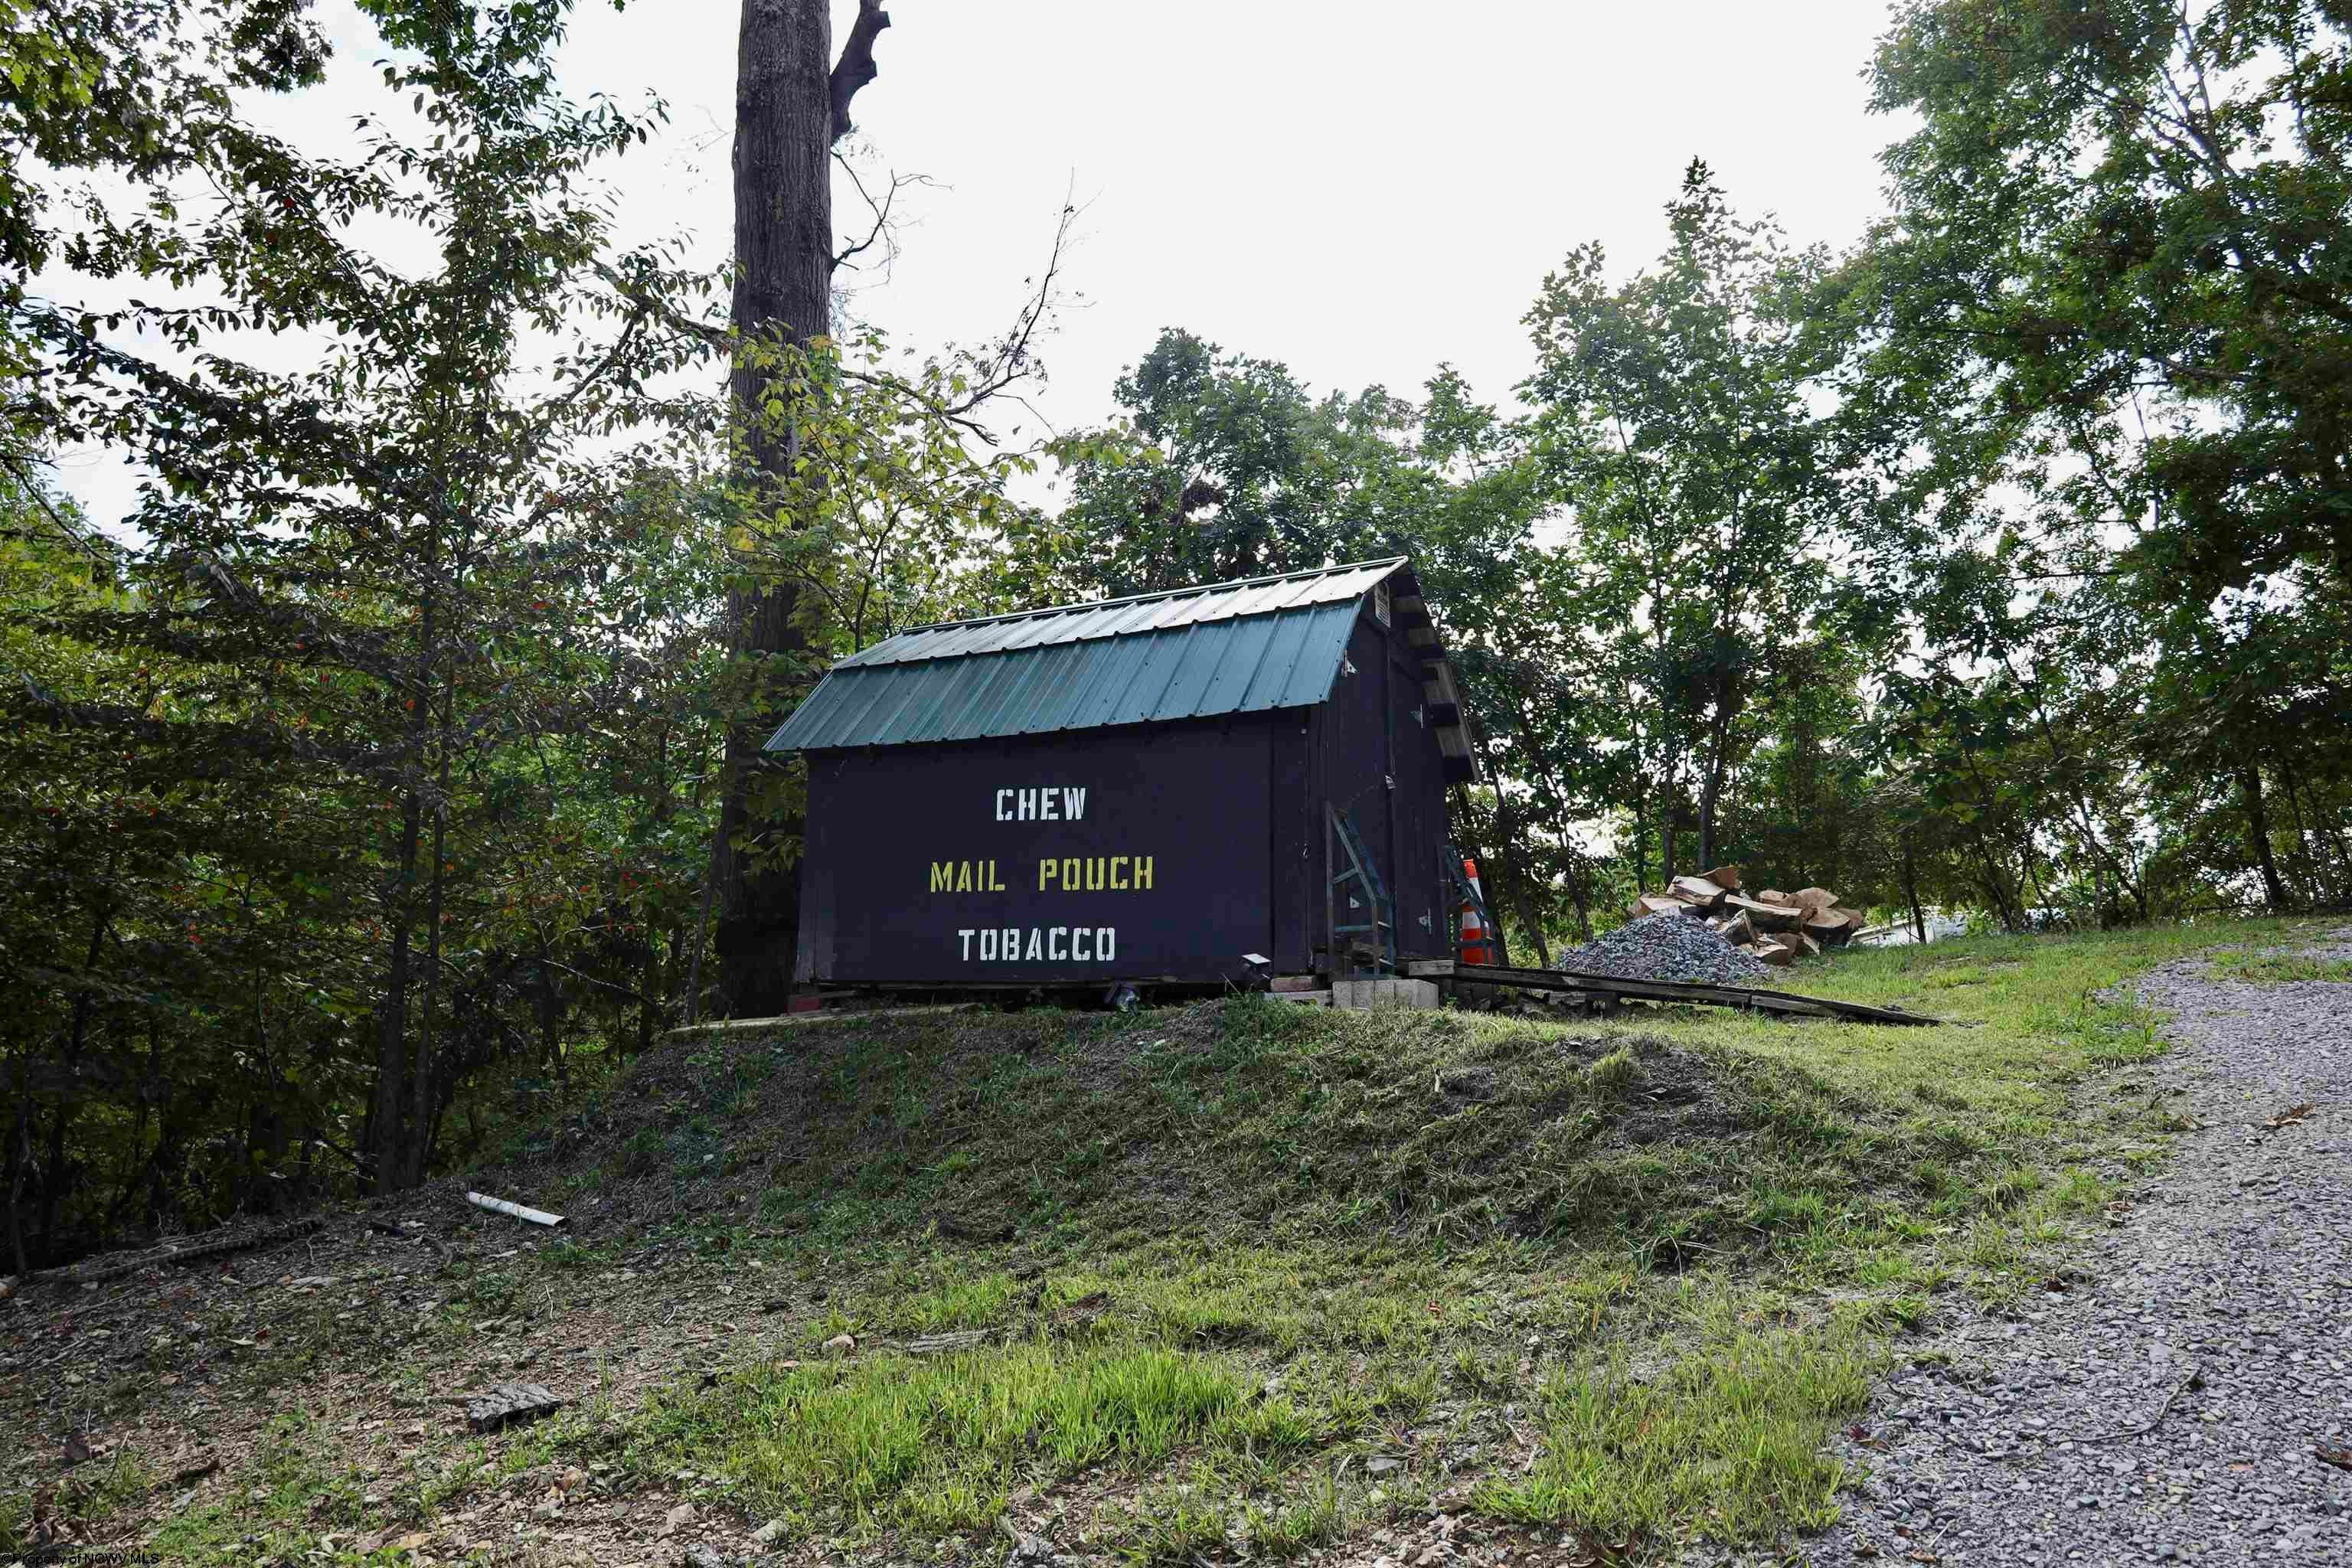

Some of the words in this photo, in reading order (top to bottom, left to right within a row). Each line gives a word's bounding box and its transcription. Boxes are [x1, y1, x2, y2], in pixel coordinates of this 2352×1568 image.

[996, 787, 1086, 822] CHEW
[930, 860, 1005, 893] MAIL
[1039, 856, 1153, 891] POUCH
[958, 926, 1116, 962] TOBACCO
